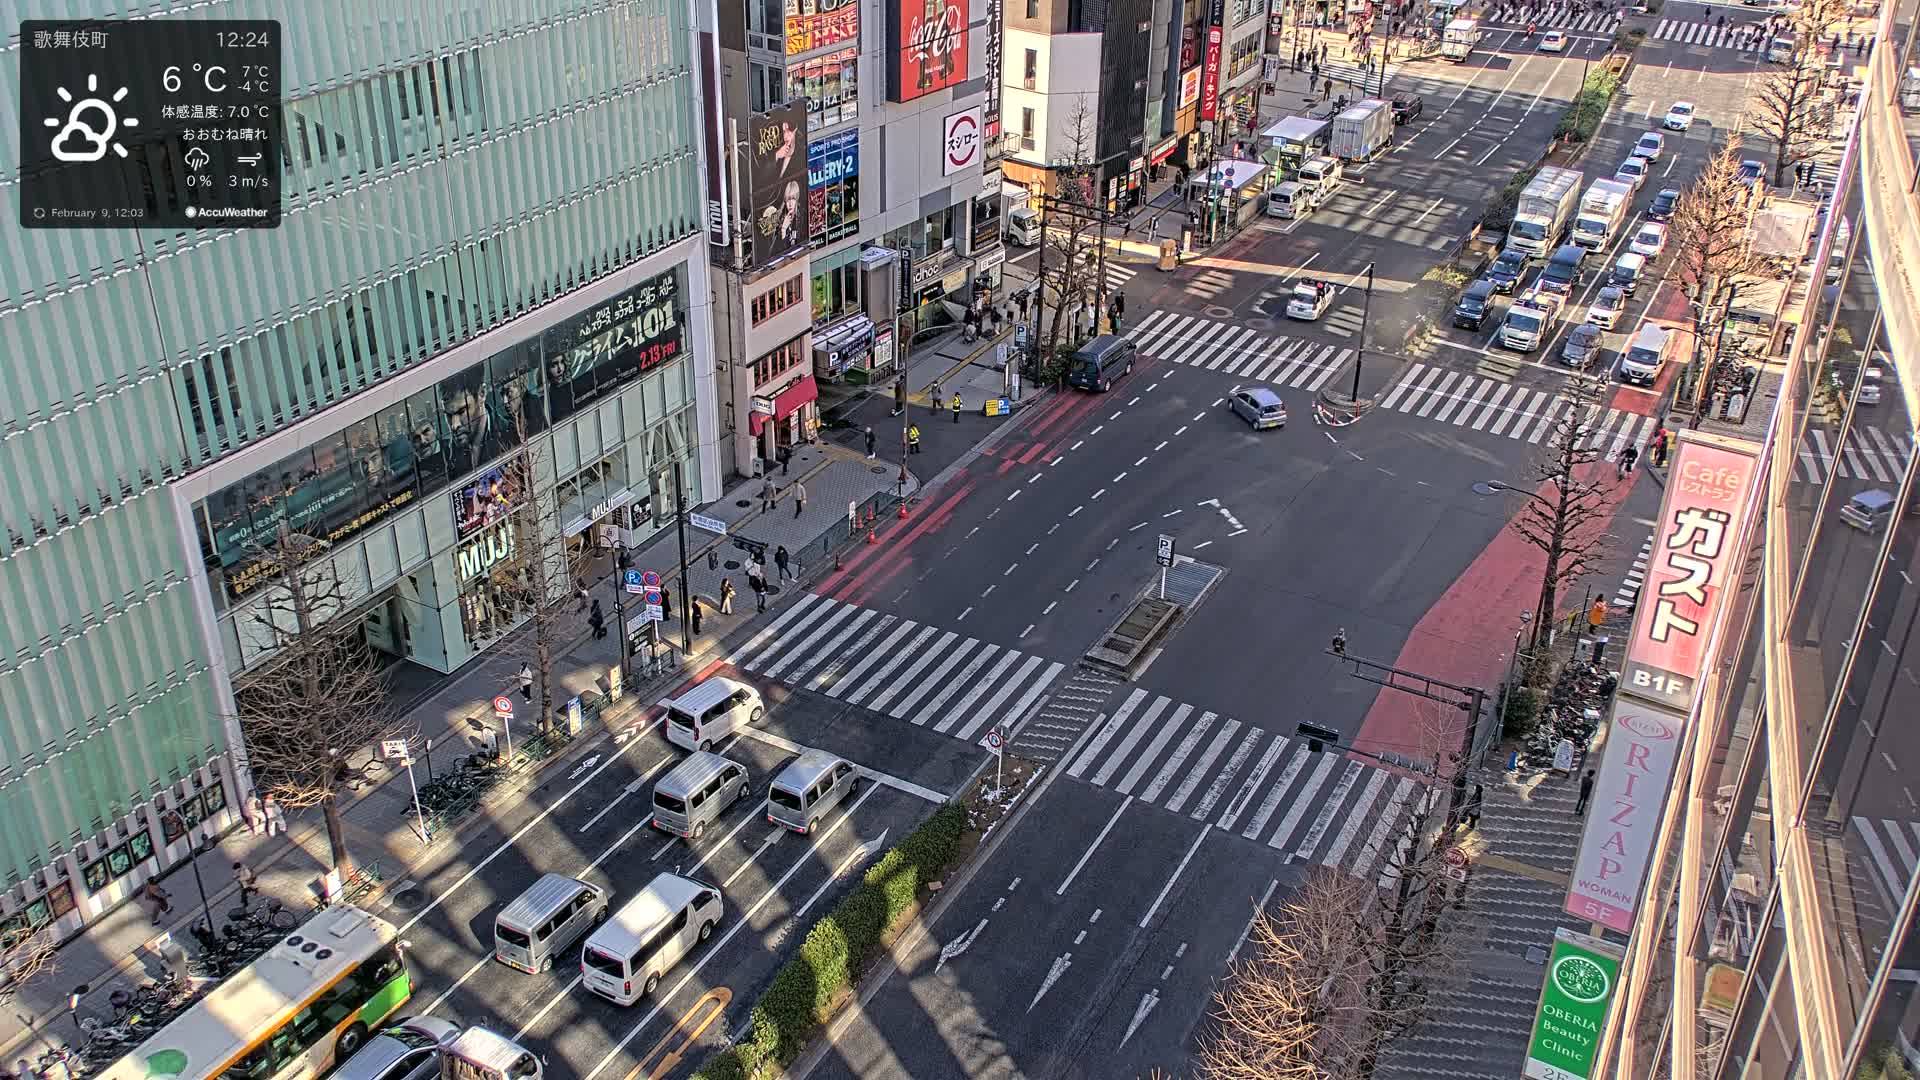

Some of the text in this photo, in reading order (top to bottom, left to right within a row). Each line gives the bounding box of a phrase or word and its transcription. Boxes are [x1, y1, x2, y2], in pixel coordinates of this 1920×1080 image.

[1205, 46, 1218, 111] バーガーキング
[947, 133, 978, 152] スシロー
[709, 199, 722, 233] MUJI
[902, 250, 909, 259] P
[1017, 326, 1025, 335] P
[640, 341, 676, 370] 2.13 FRI
[829, 352, 839, 367] P
[756, 401, 771, 410] DUG
[998, 400, 1005, 409] P
[1682, 460, 1741, 490] Café
[1679, 480, 1736, 502] レストラン
[592, 498, 614, 519] MUJI
[459, 523, 514, 582] MUJI
[1160, 540, 1168, 549] P
[628, 573, 635, 582] P
[1649, 506, 1731, 643] ガスト
[1632, 669, 1684, 696] B1F
[1596, 740, 1651, 881] RIZAP
[1578, 879, 1632, 904] WOMAN
[1584, 901, 1613, 921] 5F
[1559, 969, 1600, 991] OBERIA
[1543, 1004, 1598, 1032] OBERIA
[1543, 1019, 1591, 1047] Beauty
[1542, 1038, 1583, 1061] Clinic
